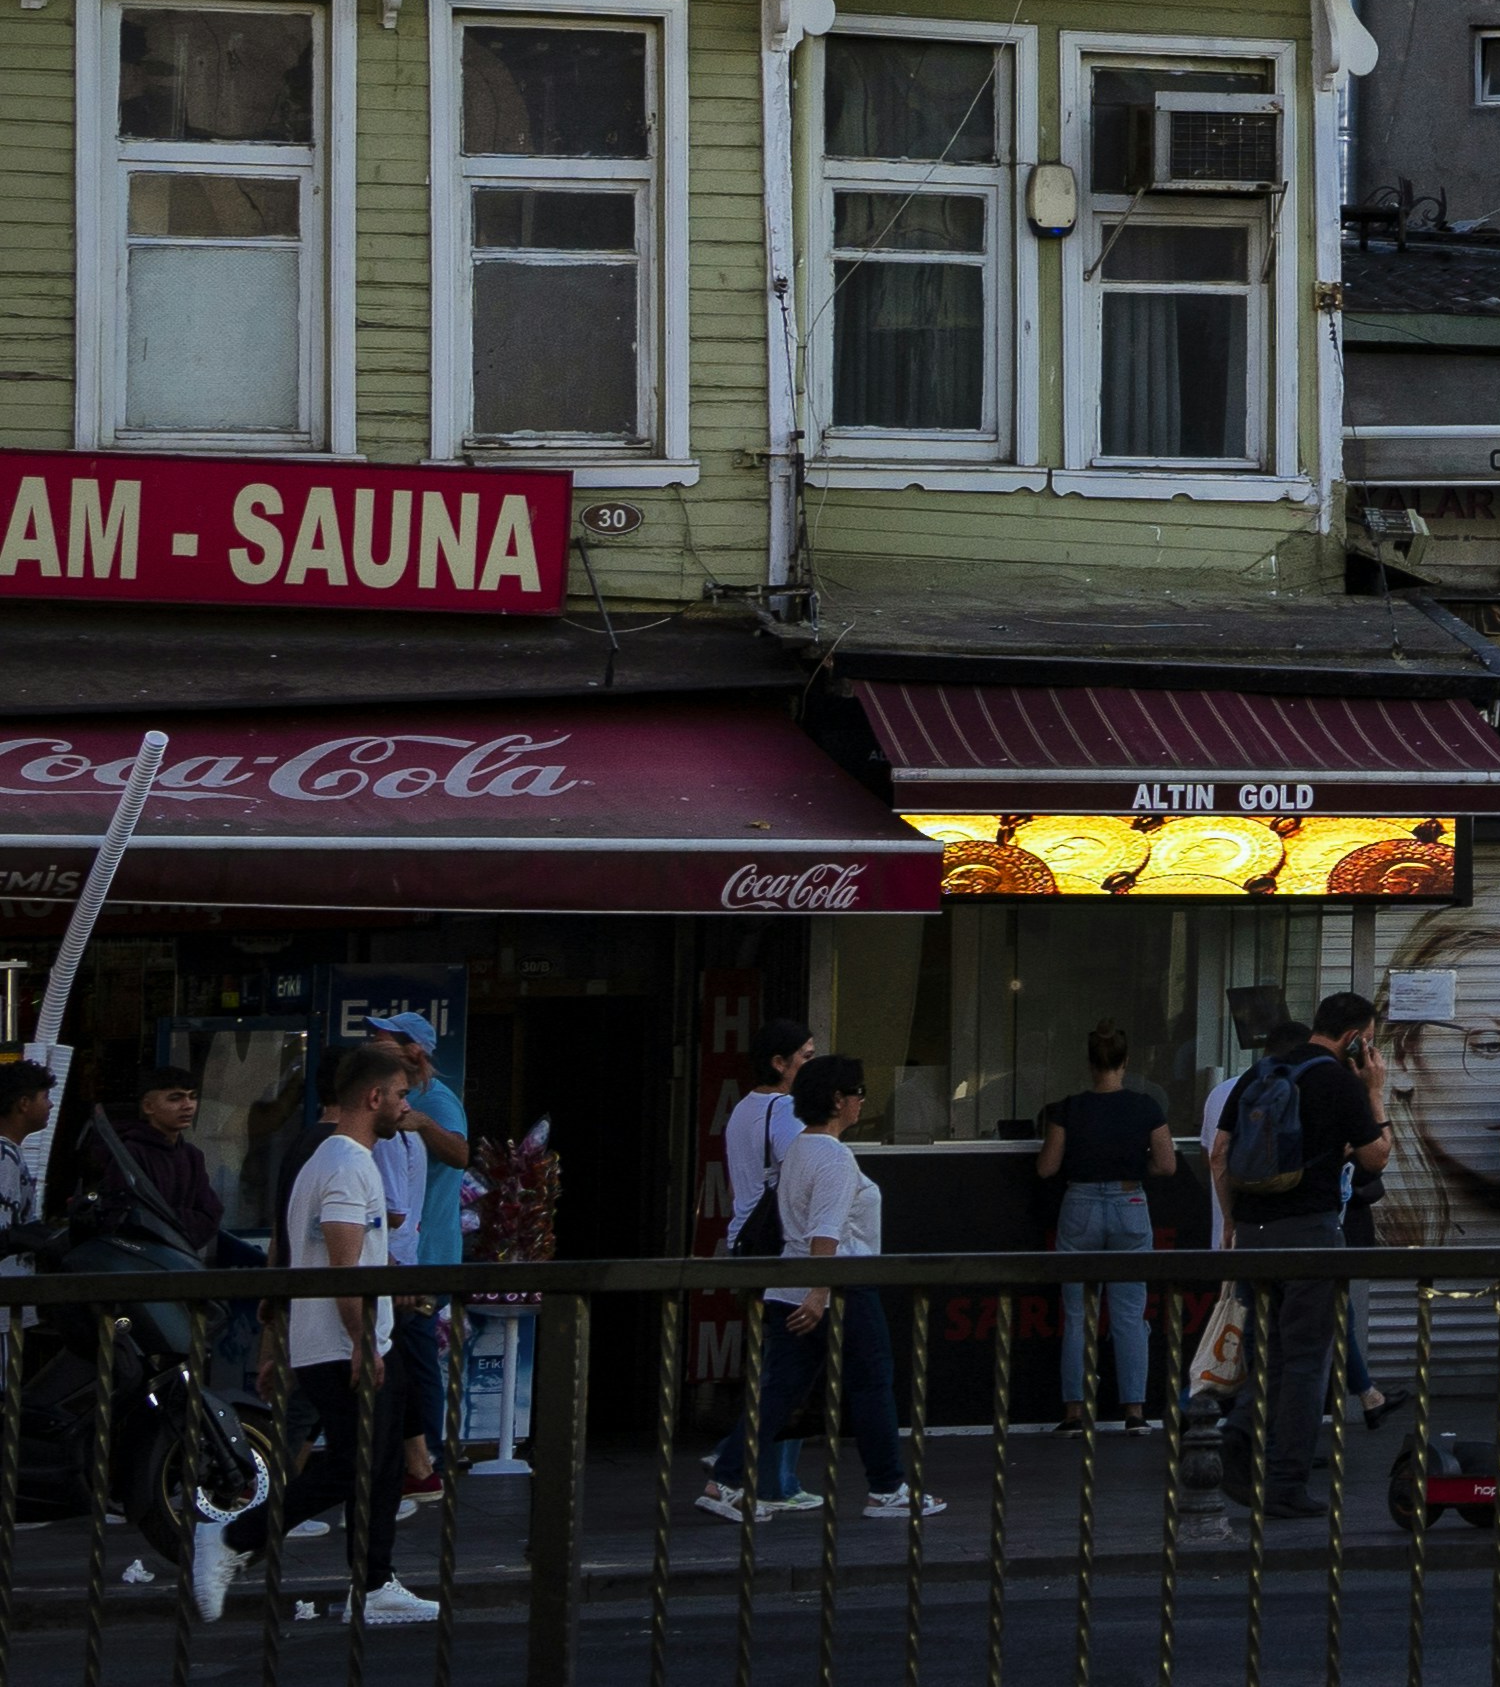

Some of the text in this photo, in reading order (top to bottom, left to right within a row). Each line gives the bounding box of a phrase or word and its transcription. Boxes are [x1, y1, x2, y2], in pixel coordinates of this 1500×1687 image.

[228, 483, 542, 593] SAUNA
[597, 509, 626, 528] 30
[0, 733, 577, 802] Coca-Cola
[1132, 785, 1313, 811] ALTIN GOLD
[720, 863, 868, 910] Coca-Cola
